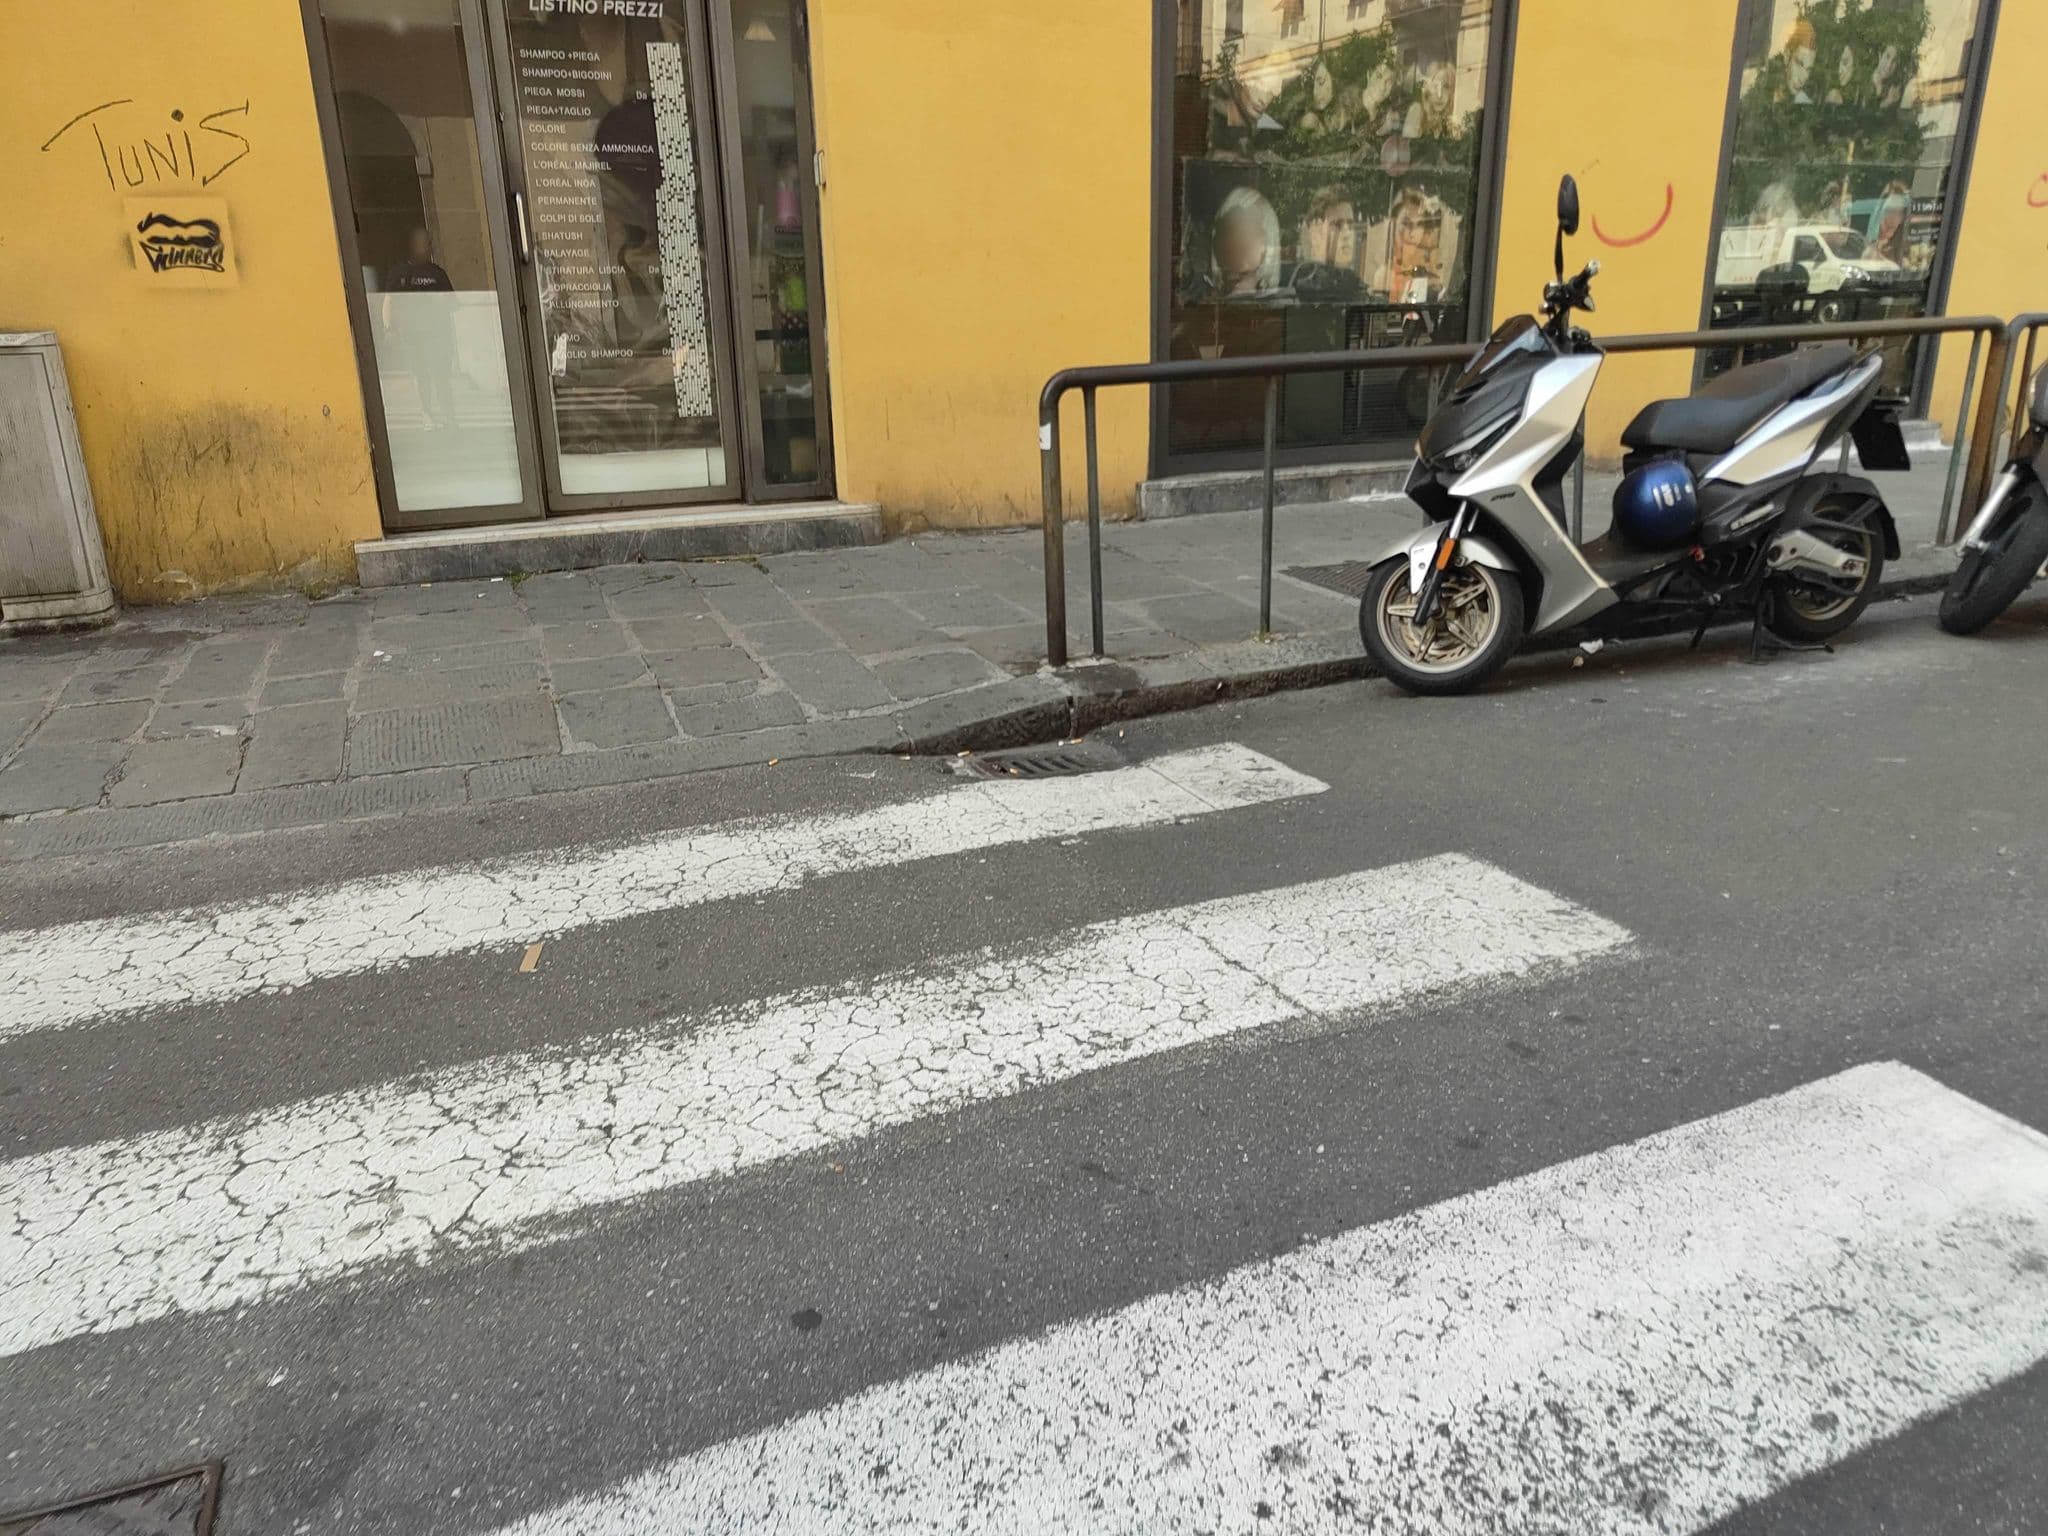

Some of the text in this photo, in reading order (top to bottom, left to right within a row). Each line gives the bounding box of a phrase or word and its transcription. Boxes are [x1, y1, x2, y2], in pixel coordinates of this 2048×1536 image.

[529, 0, 663, 18] LISTINO PREZZI
[519, 48, 566, 60] SHAMPOO
[524, 86, 553, 97] PIEGA
[556, 87, 586, 98] MOSSI
[528, 123, 567, 134] COLORE
[530, 142, 654, 154] COLORE SENZA AMMONIACA
[537, 195, 598, 206] PERMANENTE
[539, 213, 602, 223] COLPI DI SOLE
[541, 231, 583, 241] SHATUSH
[543, 248, 590, 258] BALAYAGE
[598, 265, 626, 275] LISCIA
[550, 299, 619, 310] ALLUNGAMENTO
[556, 349, 587, 359] AGLIO
[591, 348, 633, 358] SHAMPOO
